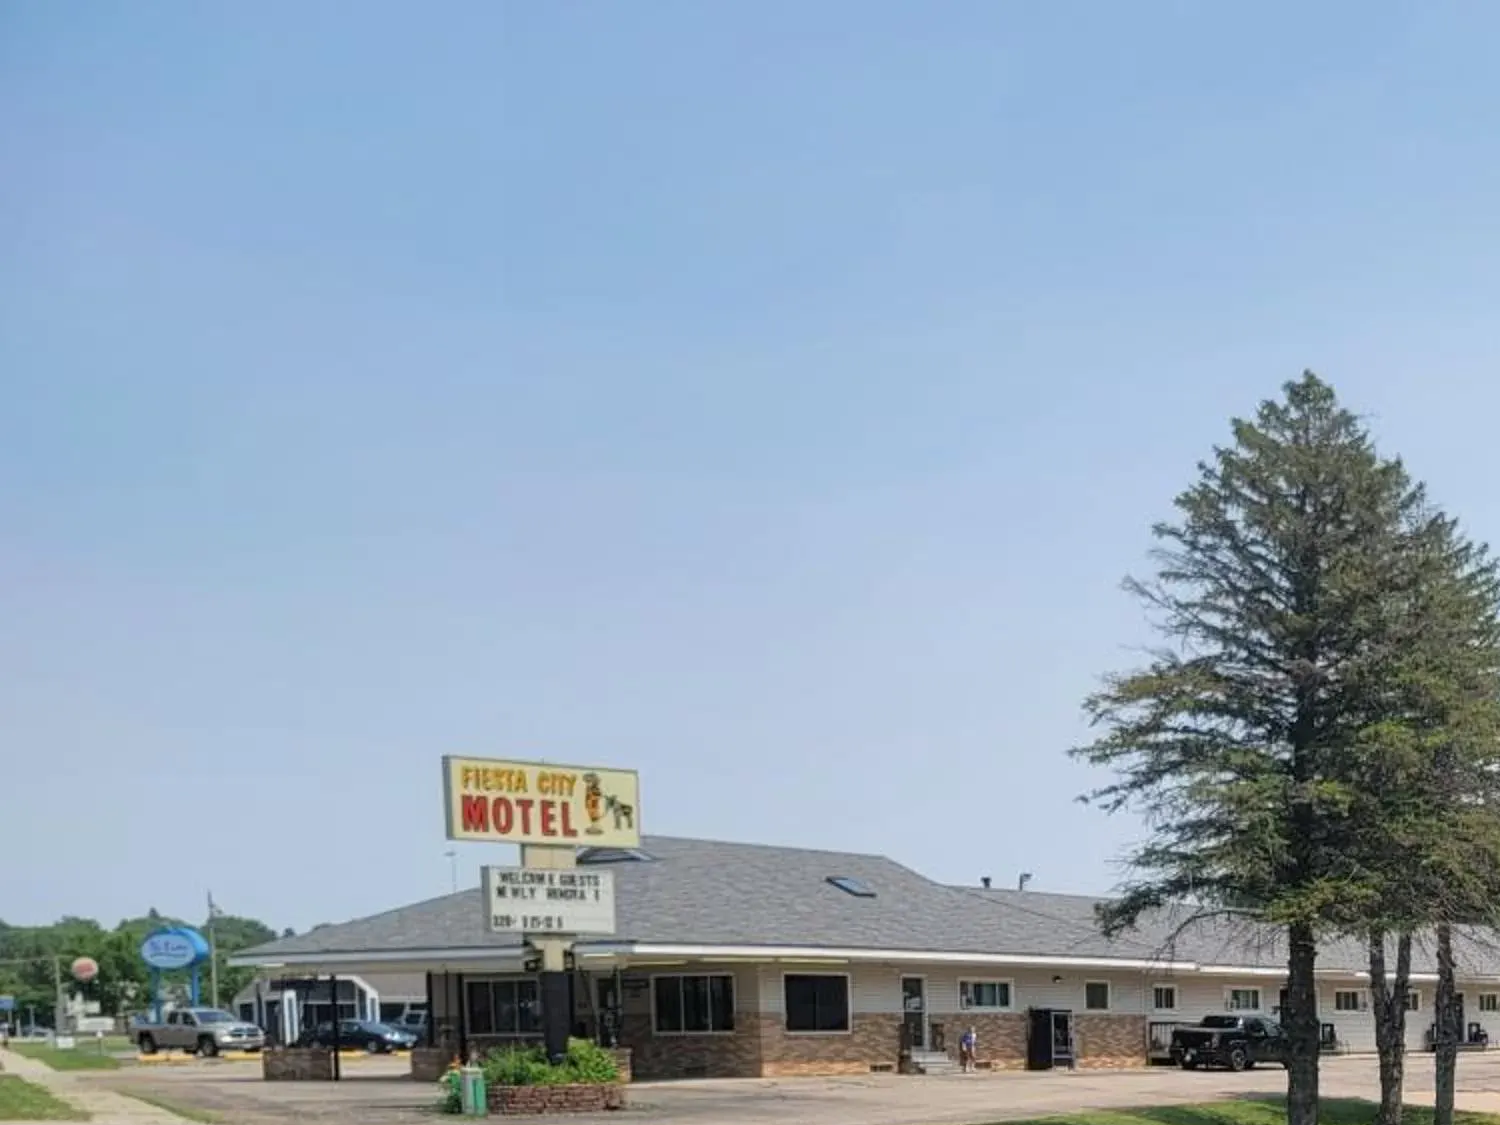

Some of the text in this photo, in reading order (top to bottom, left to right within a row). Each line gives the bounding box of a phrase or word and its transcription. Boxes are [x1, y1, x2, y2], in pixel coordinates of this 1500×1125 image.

[461, 766, 577, 797] FIESTA CITY
[461, 794, 577, 837] MOTEL
